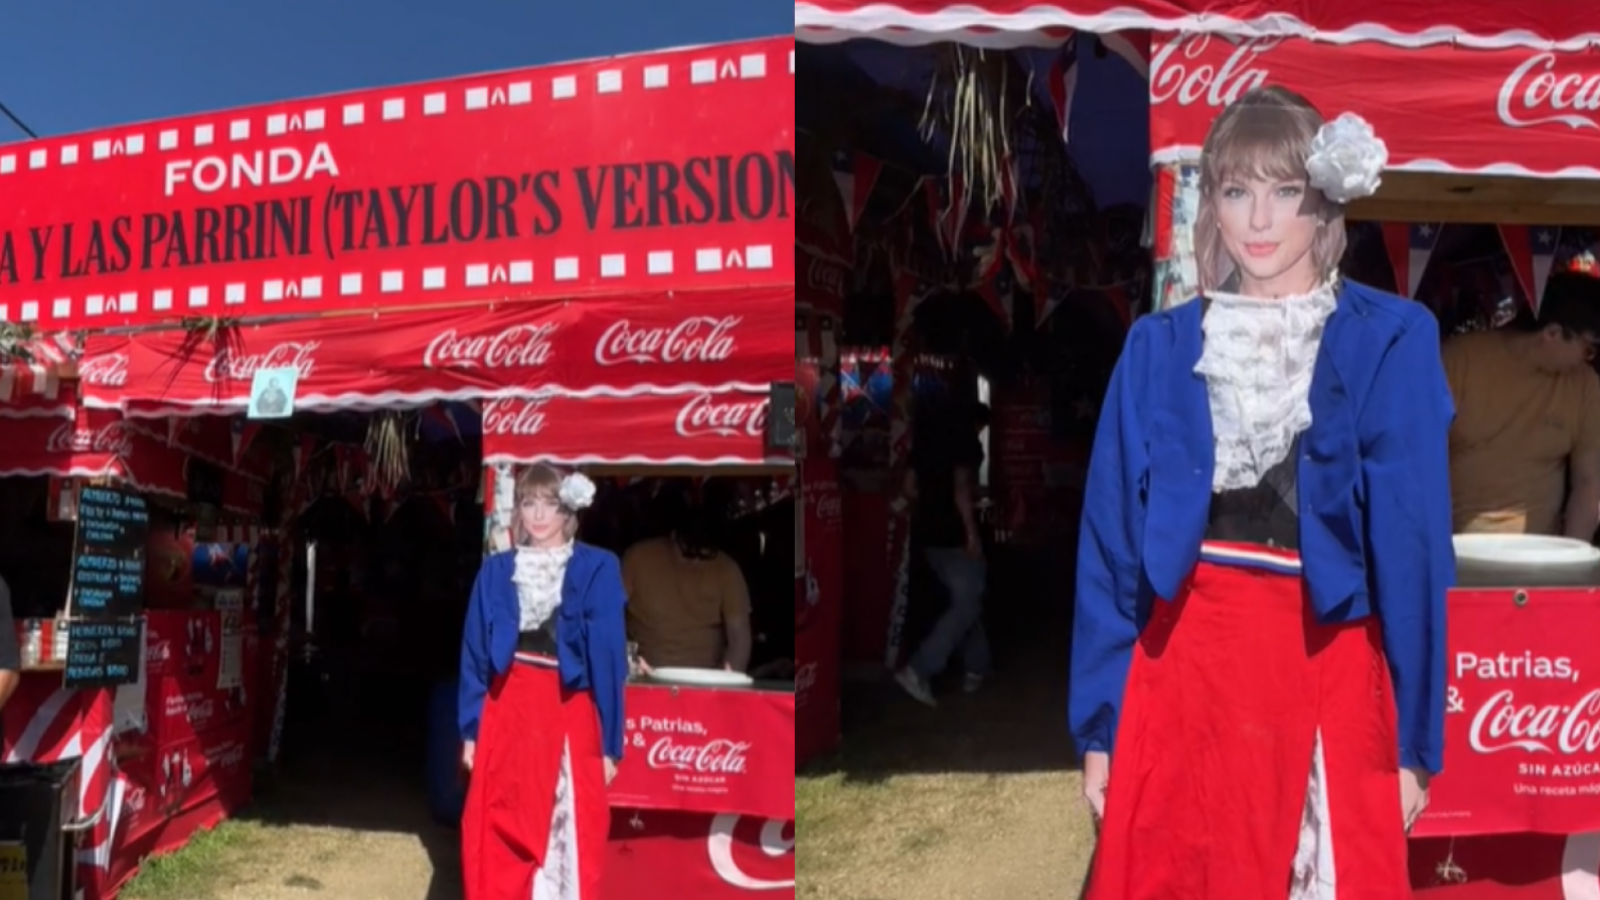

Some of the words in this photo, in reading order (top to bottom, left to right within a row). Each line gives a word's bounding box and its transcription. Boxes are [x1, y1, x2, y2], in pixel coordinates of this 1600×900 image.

[165, 143, 339, 196] FONDA
[29, 226, 54, 282] Y
[60, 215, 131, 279] LAS
[141, 195, 313, 270] PARRINI
[322, 169, 562, 260] (TAYLOR'S
[423, 322, 560, 368] Coca-Cola
[595, 315, 744, 366] Coca-Cola
[1456, 650, 1580, 683] Patrias,
[641, 716, 707, 736] Patrias,
[647, 735, 753, 774] Coca-Cola
[1518, 763, 1546, 776] SIN
